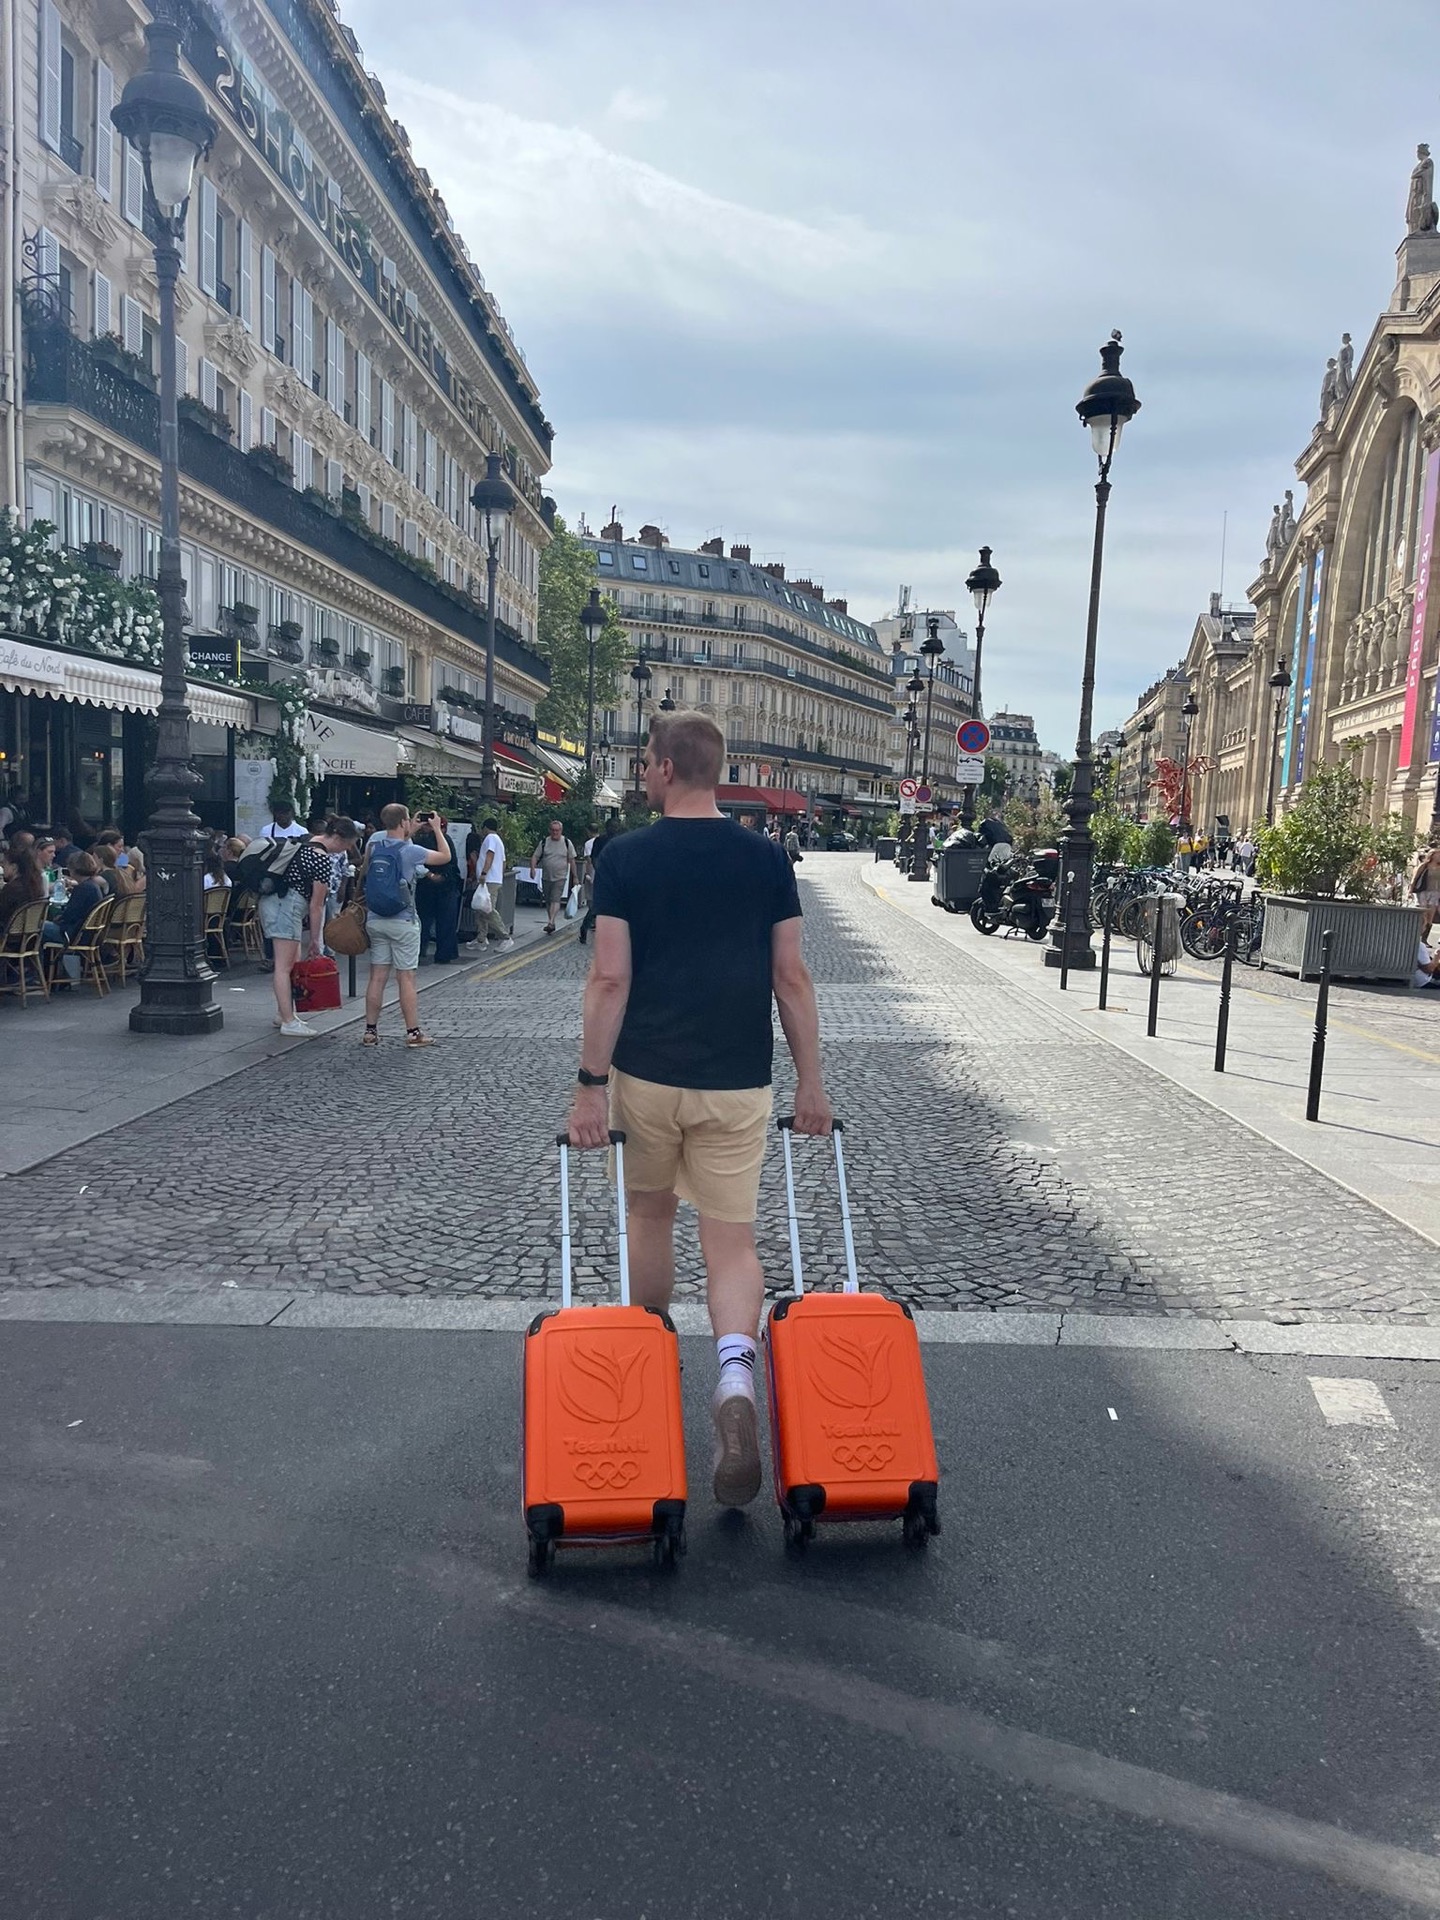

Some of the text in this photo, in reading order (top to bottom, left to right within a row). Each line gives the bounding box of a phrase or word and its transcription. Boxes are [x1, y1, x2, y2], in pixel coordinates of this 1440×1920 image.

[1409, 533, 1431, 688] PARIS 2024
[20, 655, 32, 669] du
[34, 656, 61, 674] Nord
[191, 652, 232, 662] CHANGE
[306, 714, 335, 743] NE
[322, 758, 357, 770] NCHE
